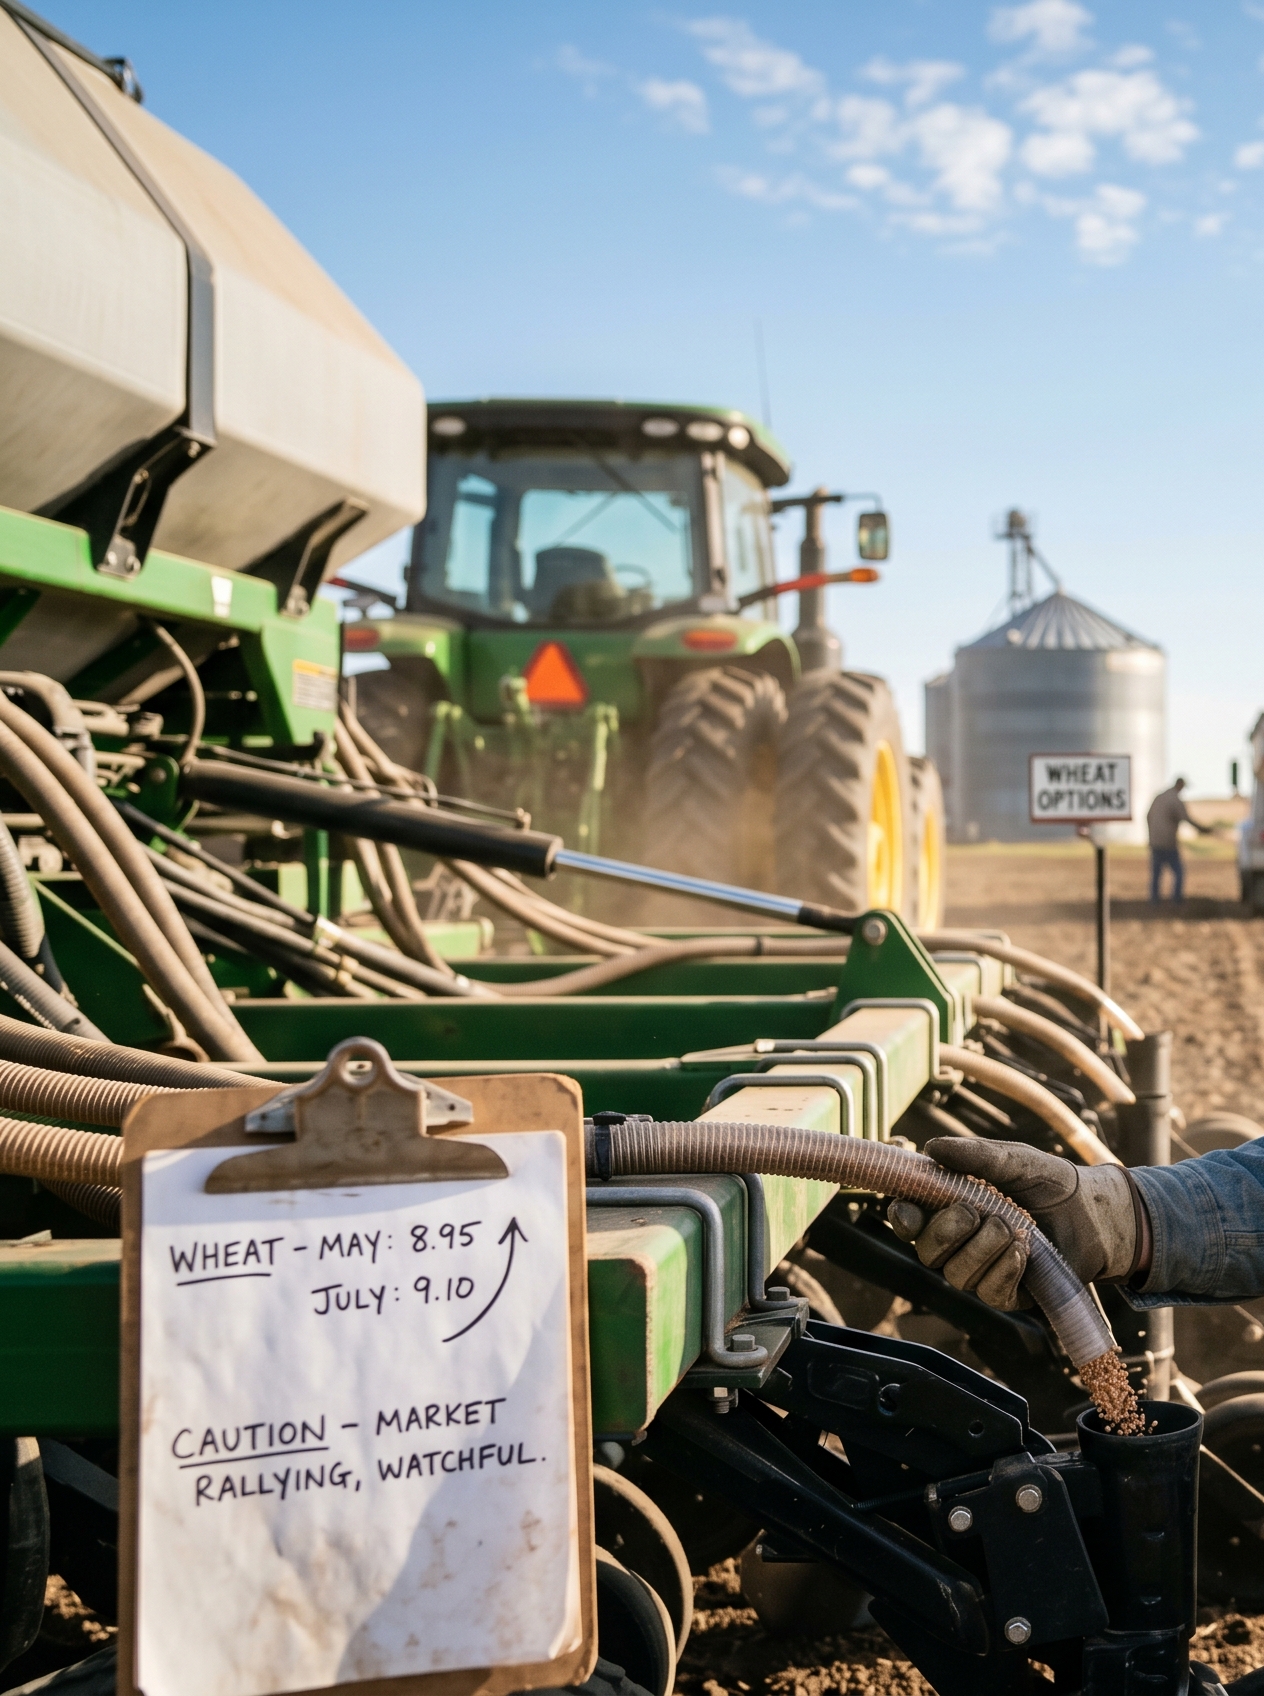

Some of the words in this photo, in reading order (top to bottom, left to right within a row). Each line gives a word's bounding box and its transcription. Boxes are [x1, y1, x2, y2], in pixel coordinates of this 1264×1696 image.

[1045, 762, 1117, 784] WHEAT
[1037, 788, 1126, 811] OPTIONS
[170, 1236, 285, 1273] WHEAT
[318, 1229, 394, 1264] MAY:
[410, 1220, 483, 1253] 8.95
[311, 1283, 401, 1316] JULY:
[413, 1275, 475, 1304] 9.10
[171, 1415, 326, 1460] CAUTION
[375, 1397, 507, 1436] MARKET
[195, 1461, 362, 1507] RALLYING,
[377, 1442, 547, 1481] WATCHFUL.
